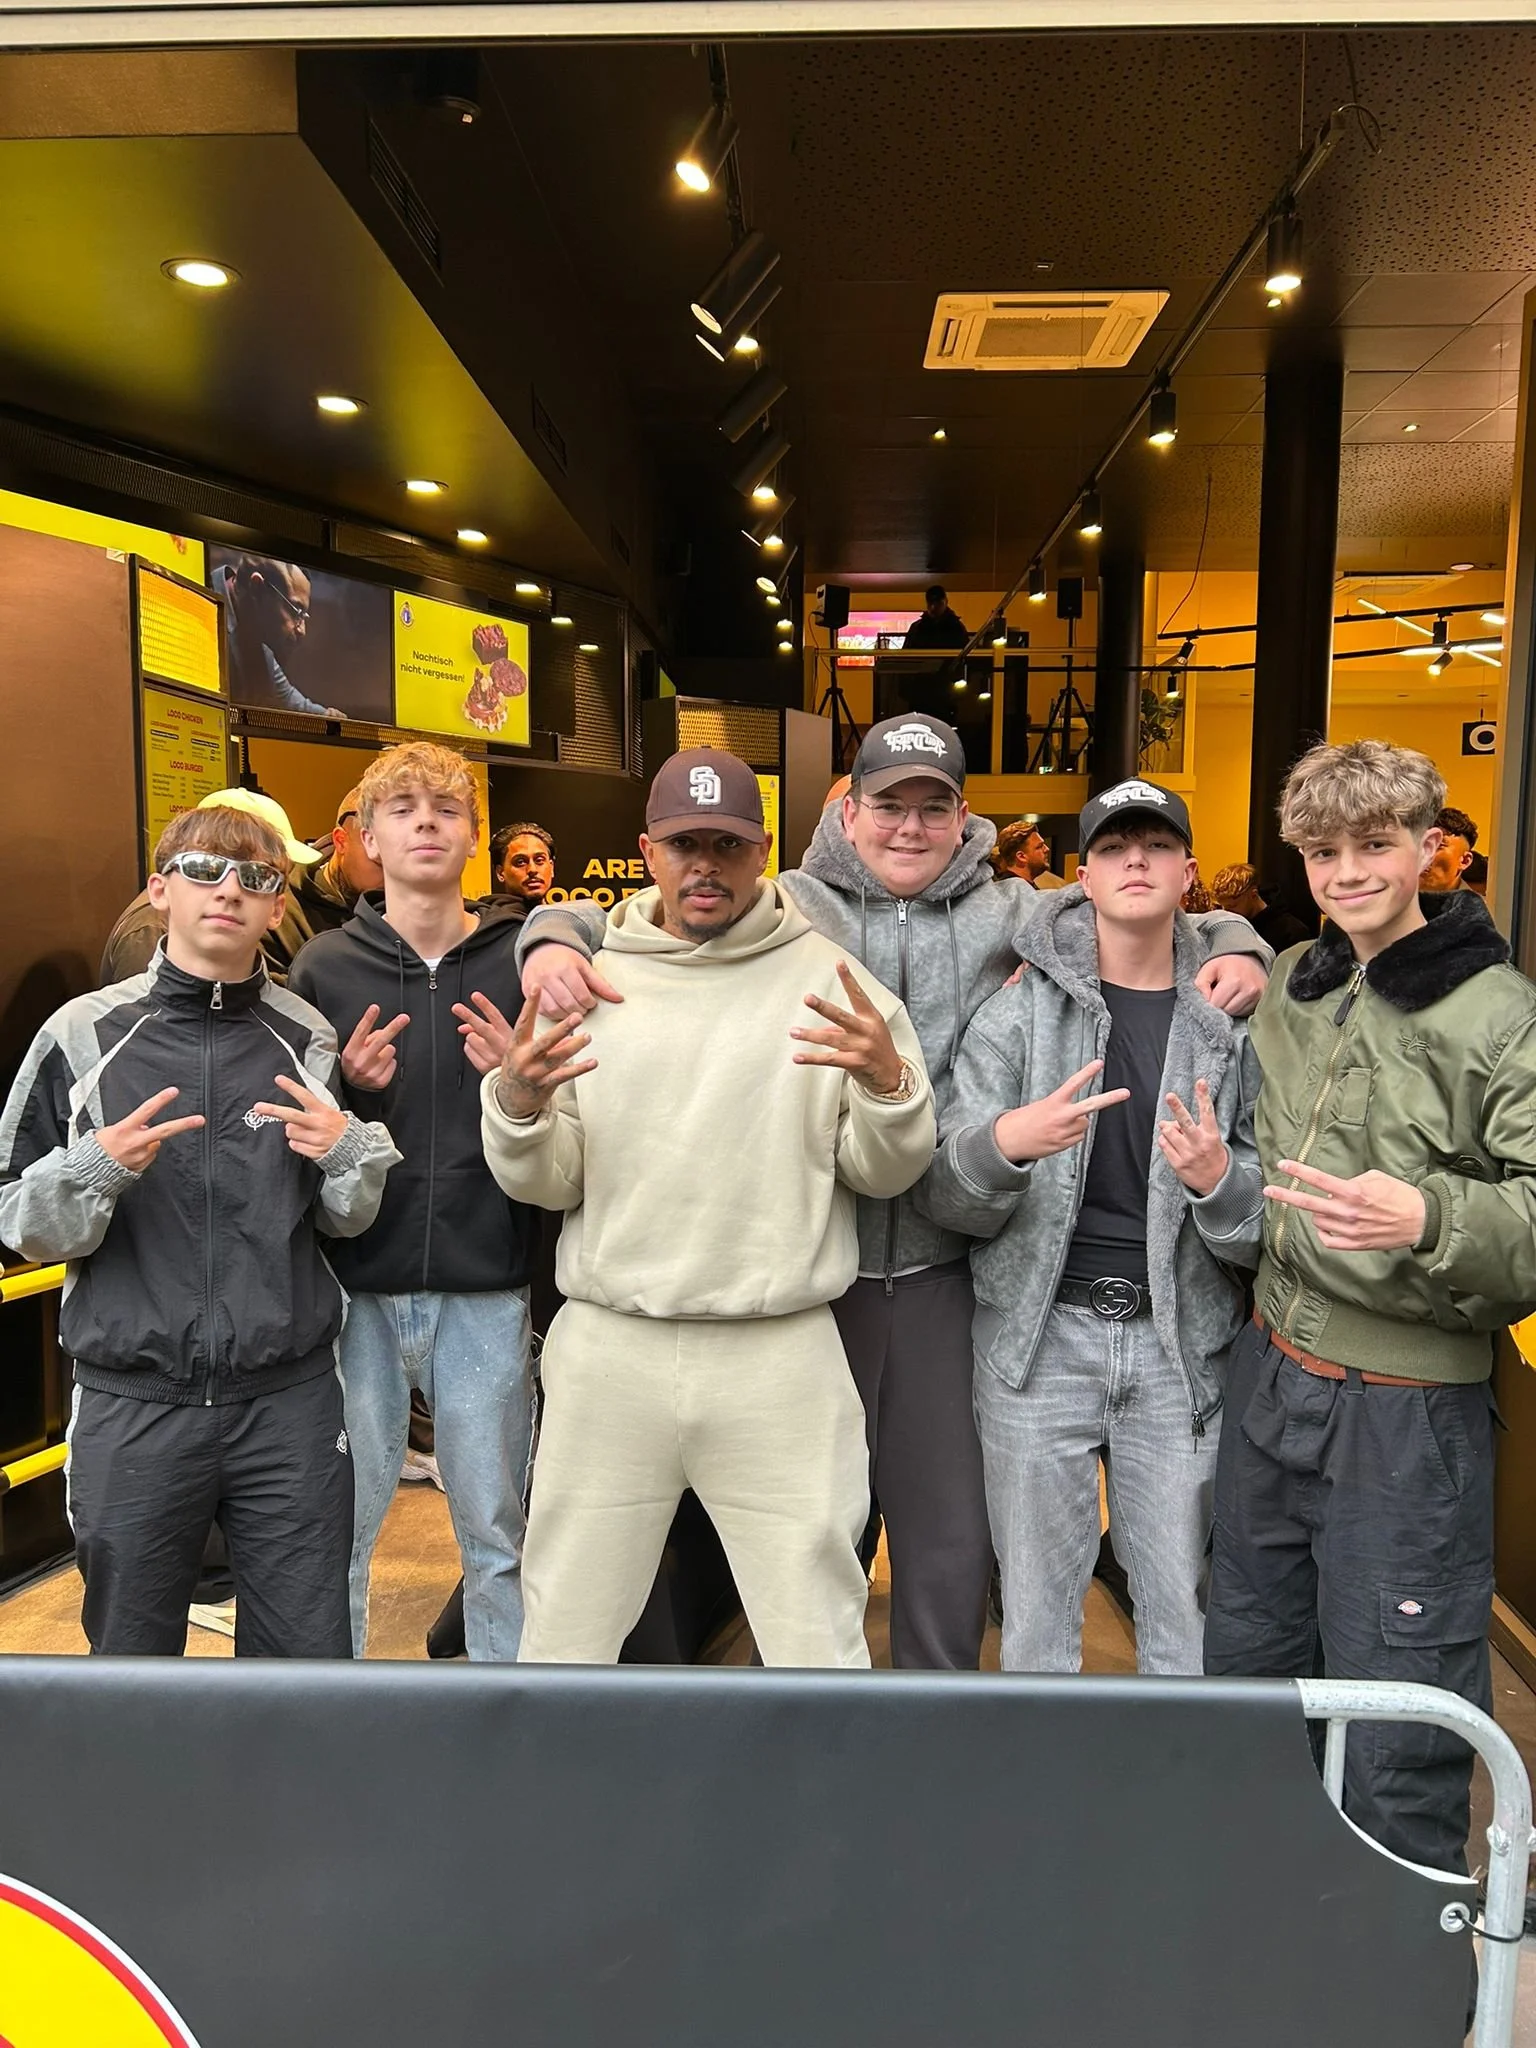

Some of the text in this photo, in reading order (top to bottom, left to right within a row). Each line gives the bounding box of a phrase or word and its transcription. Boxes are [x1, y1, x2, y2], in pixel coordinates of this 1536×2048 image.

[412, 650, 454, 667] Nachtisch
[400, 662, 465, 683] nicht vergessen!
[167, 708, 204, 725] LOCO CHICKEN
[169, 759, 204, 773] LOCO BURGER
[583, 858, 644, 879] ARE
[546, 887, 615, 908] OCO
